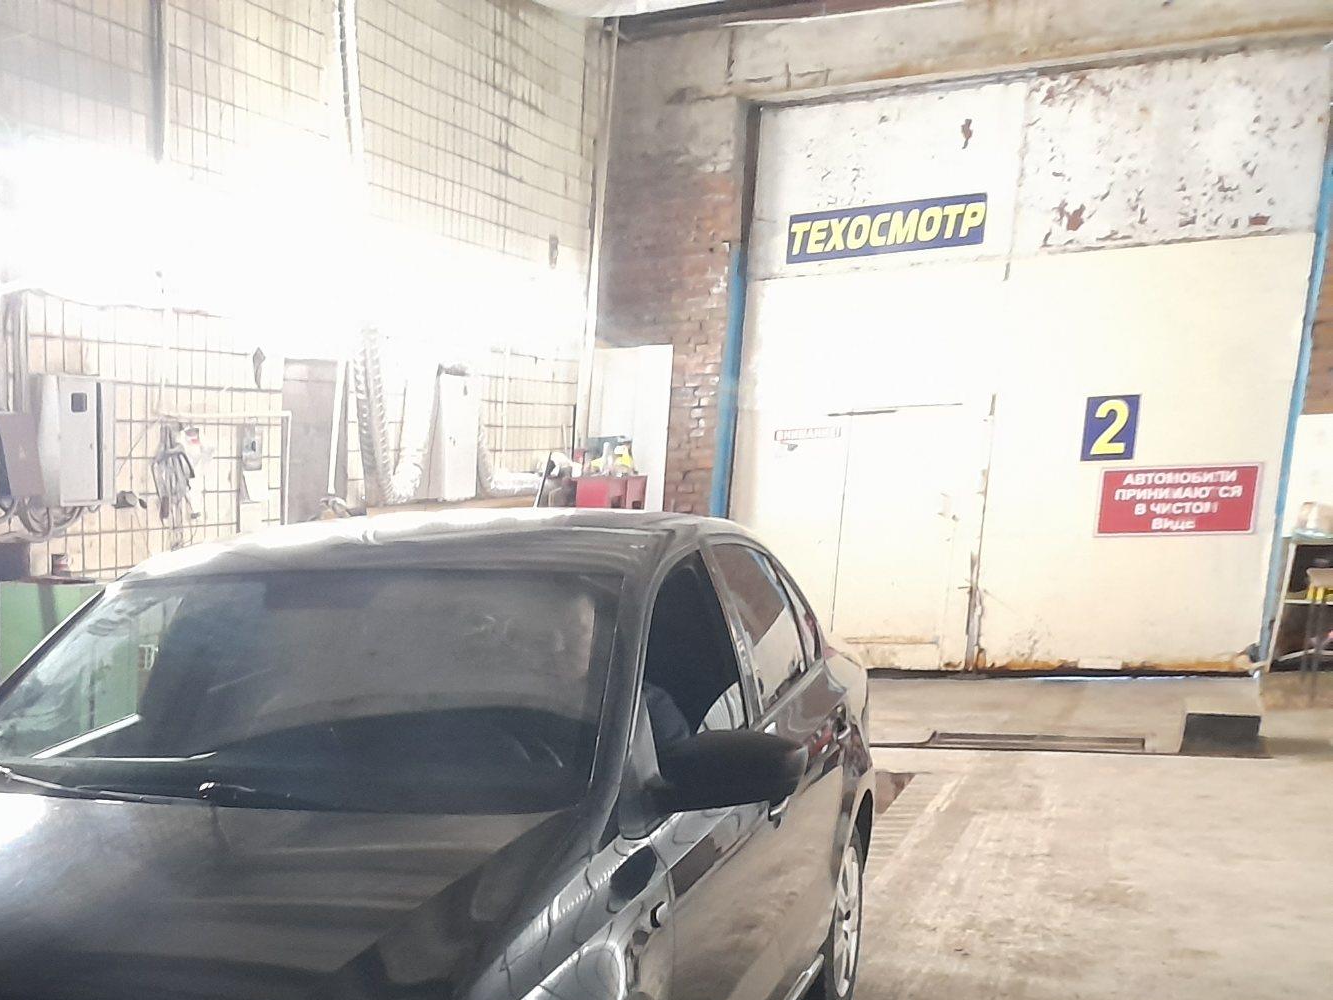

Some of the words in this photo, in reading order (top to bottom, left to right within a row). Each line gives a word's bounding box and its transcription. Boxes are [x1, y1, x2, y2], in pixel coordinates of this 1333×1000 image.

[790, 201, 986, 256] ТЕХОСМОТР
[1089, 399, 1130, 455] 2
[1134, 502, 1146, 515] В
